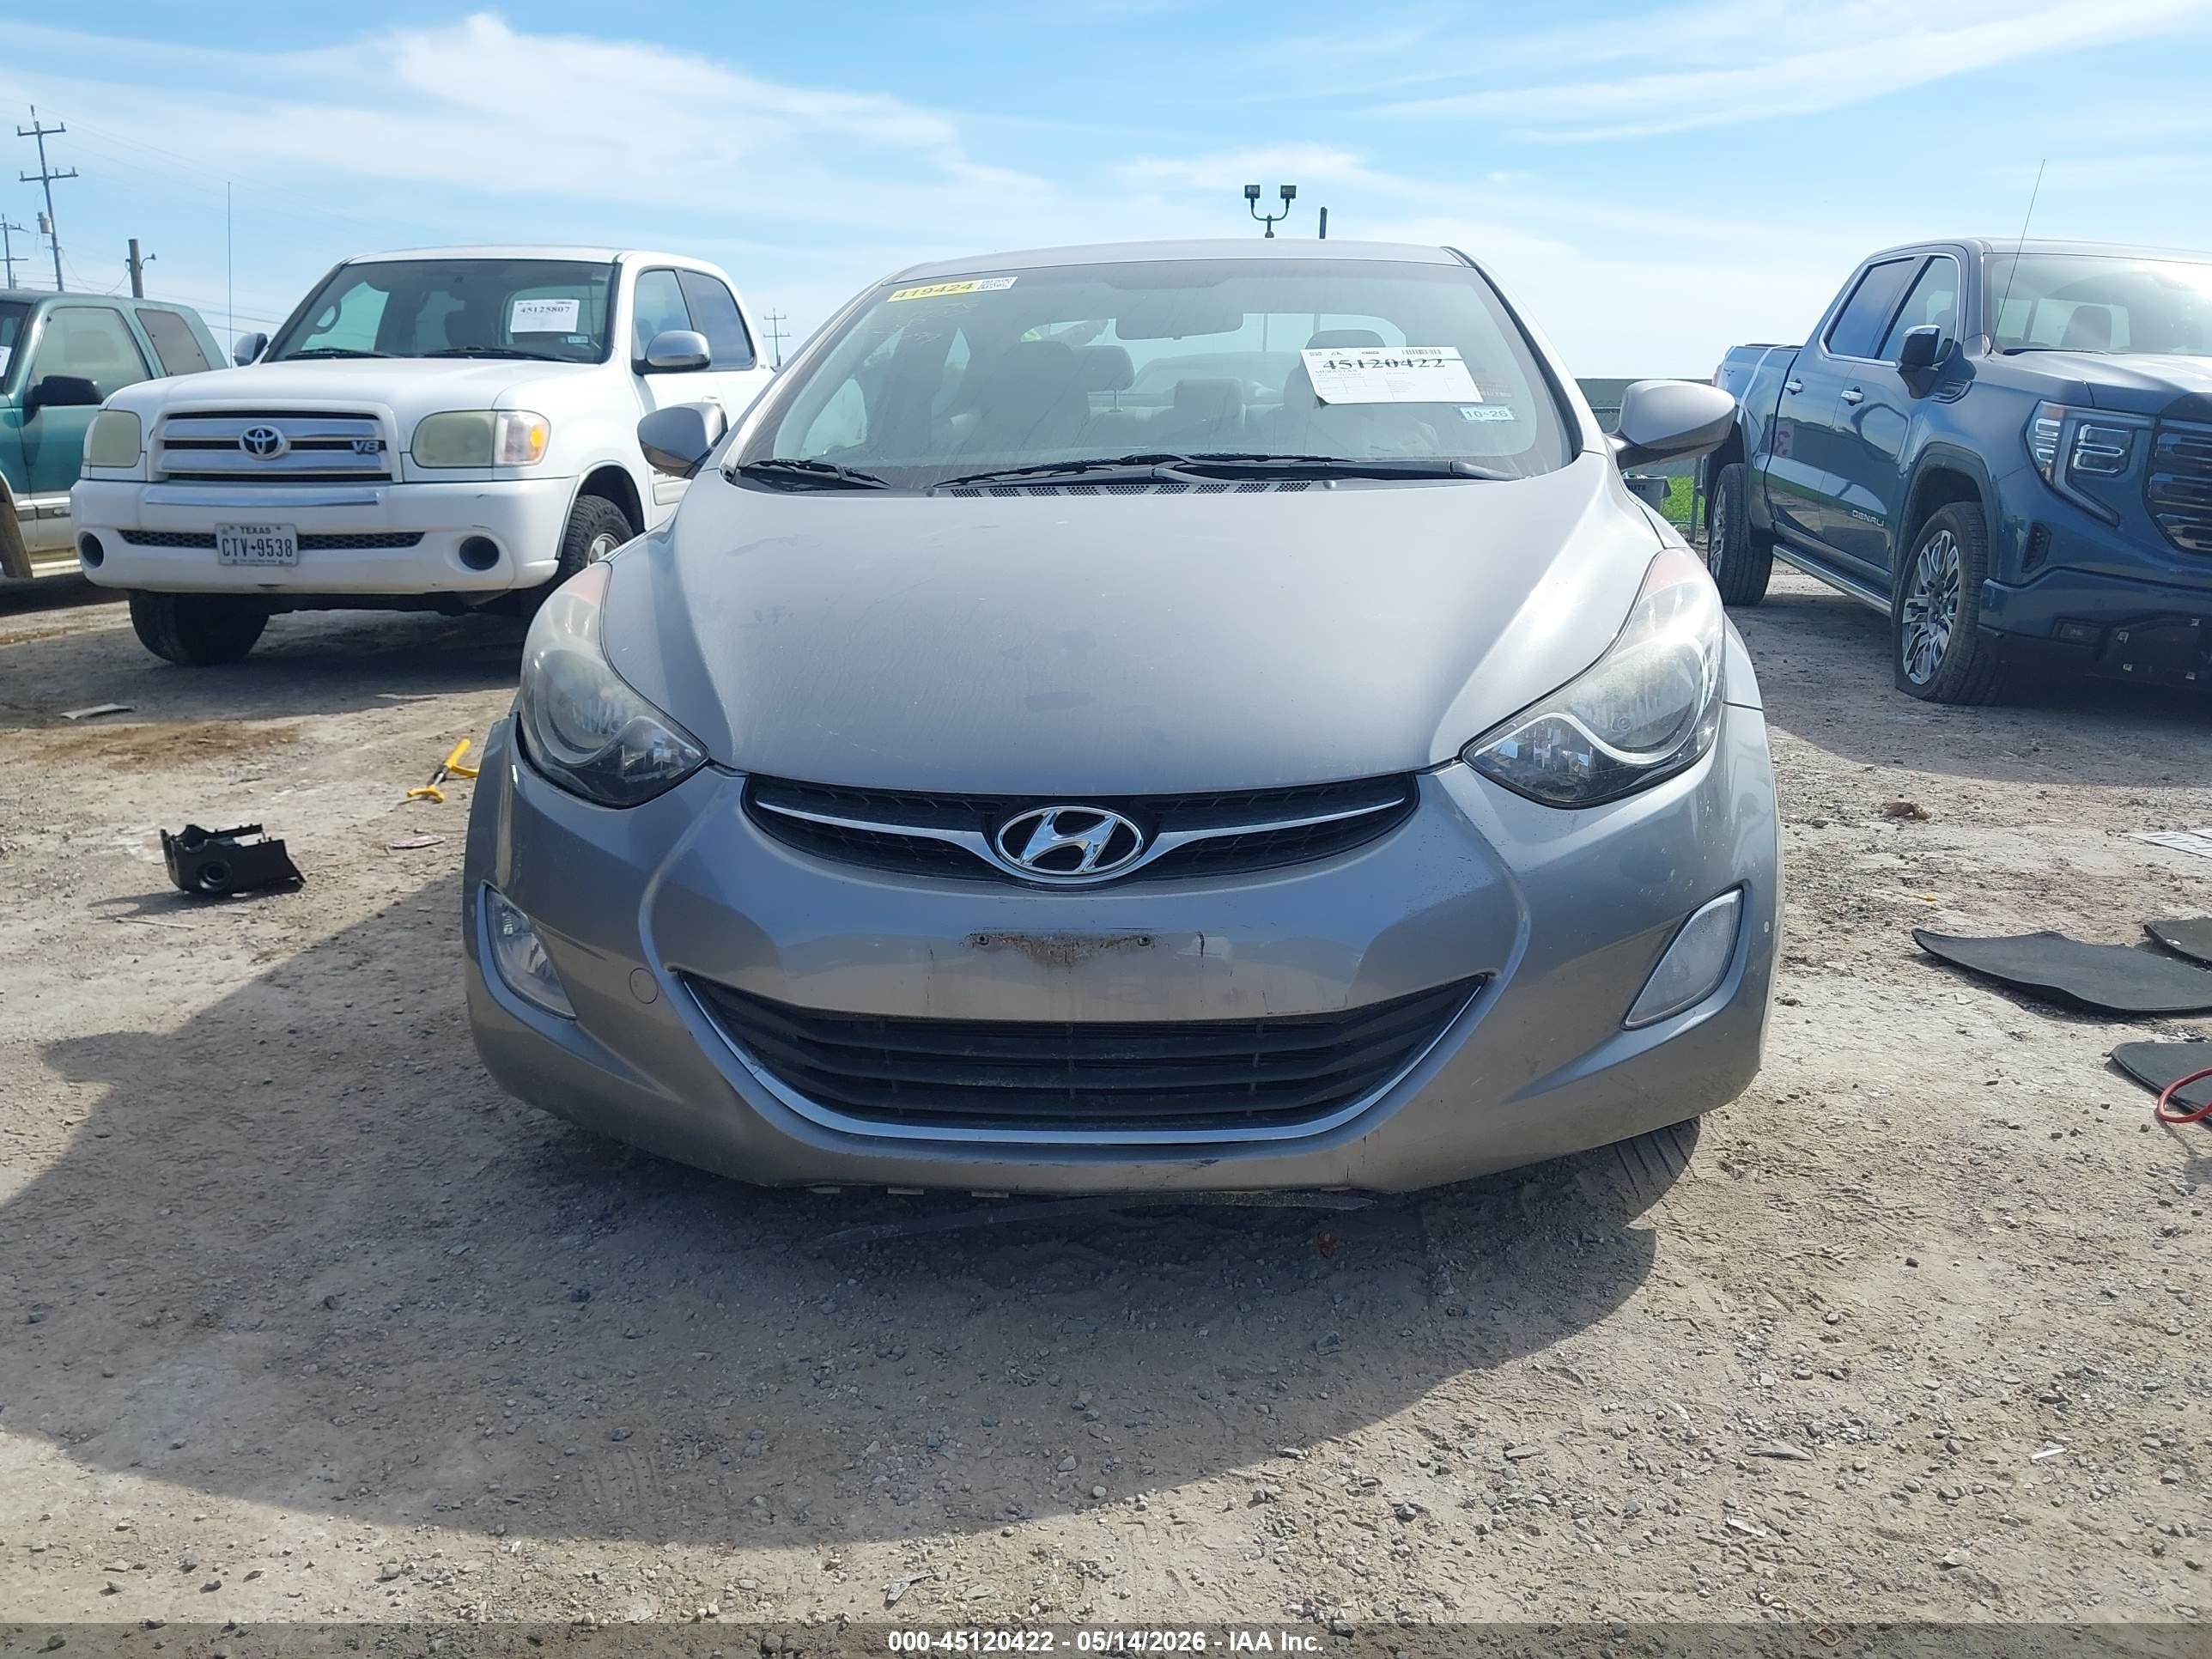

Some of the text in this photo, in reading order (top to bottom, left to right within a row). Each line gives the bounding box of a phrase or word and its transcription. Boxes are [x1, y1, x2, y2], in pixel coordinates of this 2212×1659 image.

[894, 283, 974, 298] 419424
[1323, 358, 1445, 370] 45120422
[352, 440, 380, 453] V8
[1852, 509, 1884, 528] DENALI
